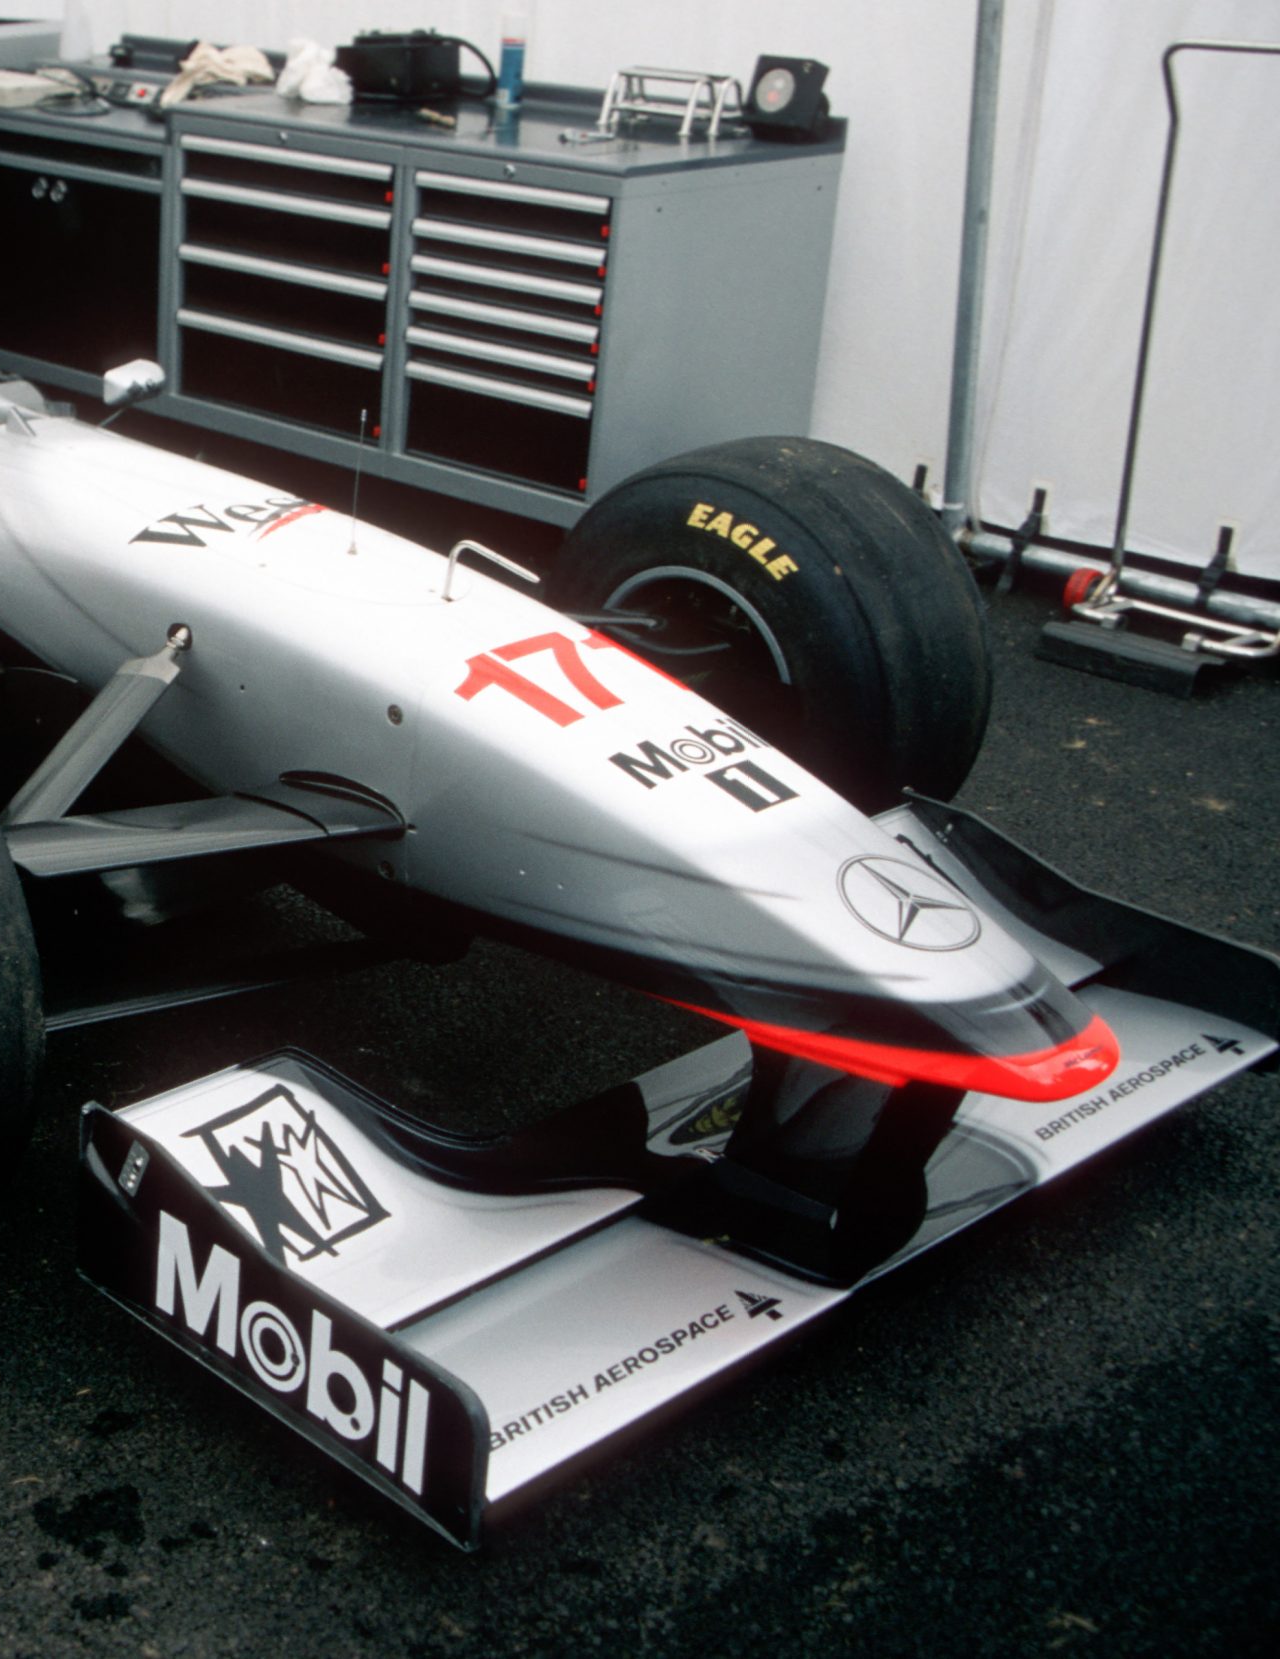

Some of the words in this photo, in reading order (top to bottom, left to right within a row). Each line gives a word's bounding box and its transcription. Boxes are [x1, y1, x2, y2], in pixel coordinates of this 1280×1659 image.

[687, 503, 799, 581] EAGLE
[608, 719, 773, 790] Mobil
[1035, 1096, 1109, 1141] BRITISH
[1108, 1043, 1206, 1103] AEROSPACE
[156, 1210, 430, 1496] Mobil
[489, 1384, 590, 1450] BRITISH
[594, 1304, 735, 1393] AEROSPACE
